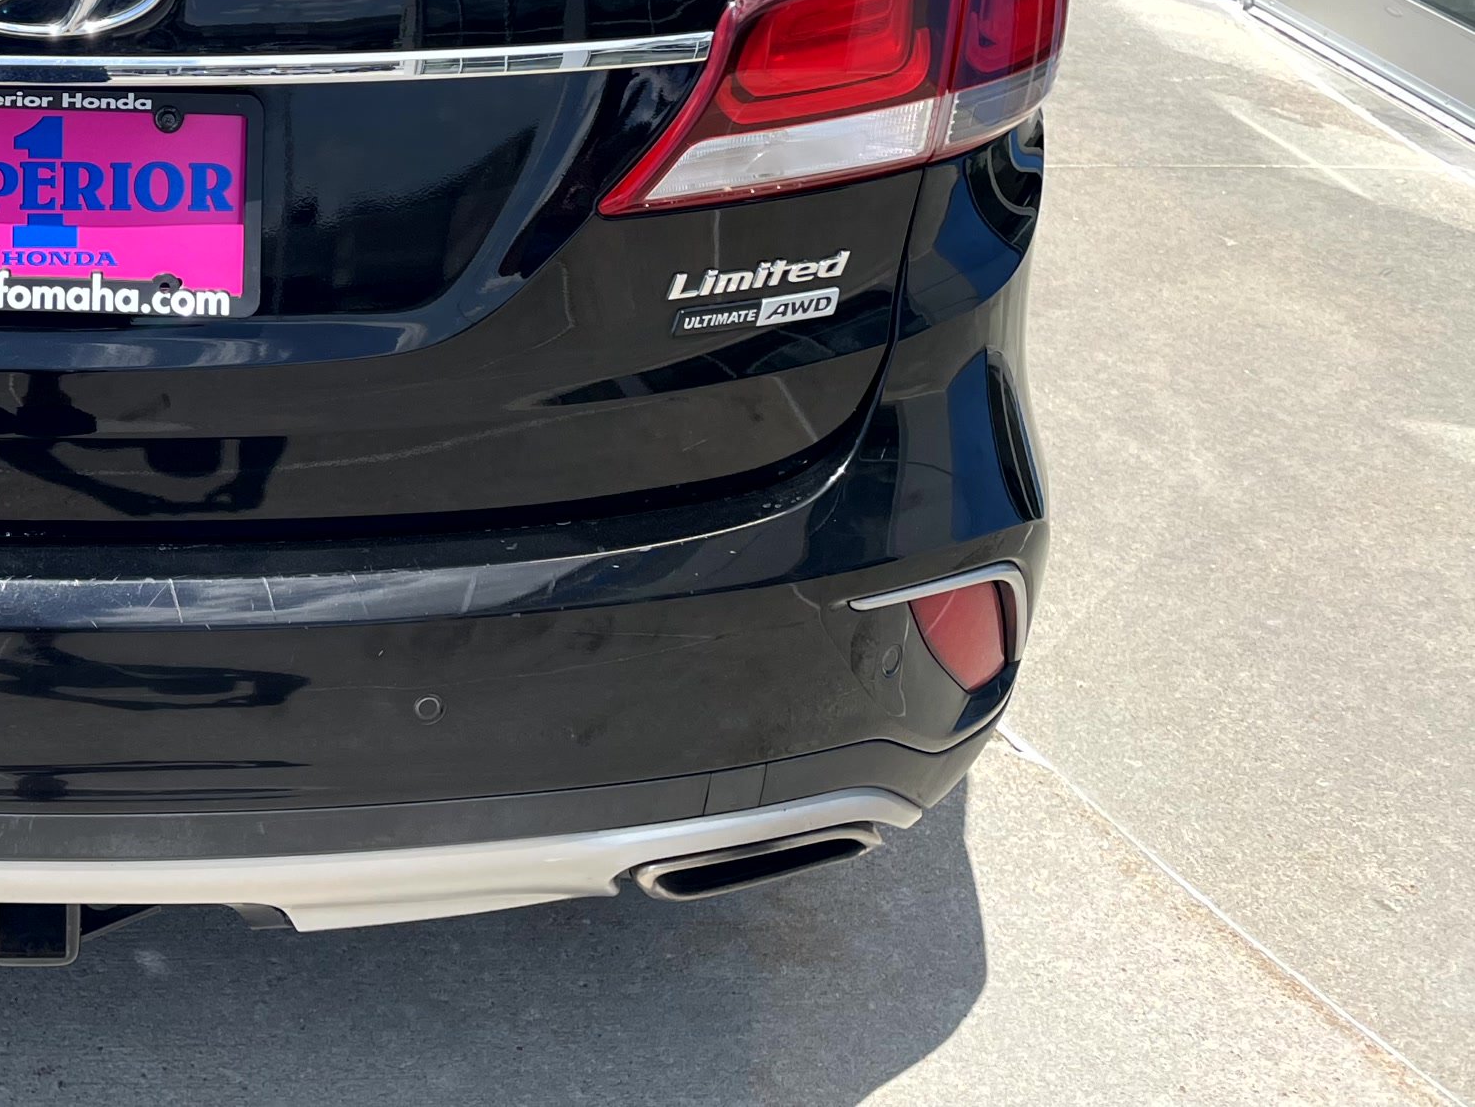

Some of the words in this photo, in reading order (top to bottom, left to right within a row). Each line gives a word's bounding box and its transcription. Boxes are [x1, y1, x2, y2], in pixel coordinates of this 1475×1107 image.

[61, 93, 153, 110] Honda
[2, 251, 118, 267] HONDA
[668, 250, 851, 301] Limited
[683, 308, 758, 330] ULTIMATE
[765, 296, 832, 320] AWD
